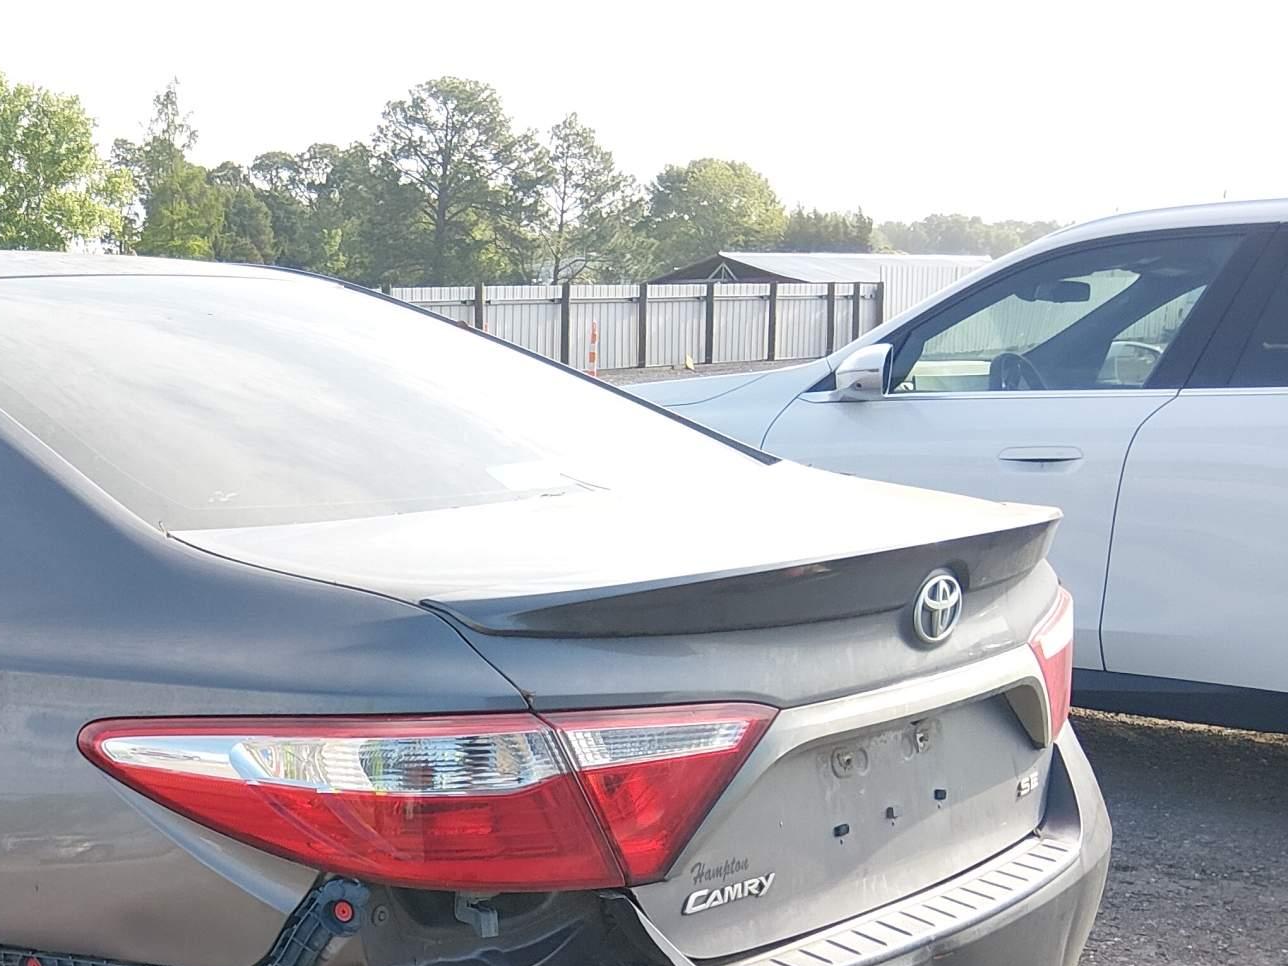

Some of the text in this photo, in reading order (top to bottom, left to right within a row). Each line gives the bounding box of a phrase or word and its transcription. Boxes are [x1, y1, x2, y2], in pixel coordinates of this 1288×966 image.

[1017, 771, 1039, 797] SE
[691, 857, 750, 885] Hampton
[681, 872, 775, 915] CAMRY
